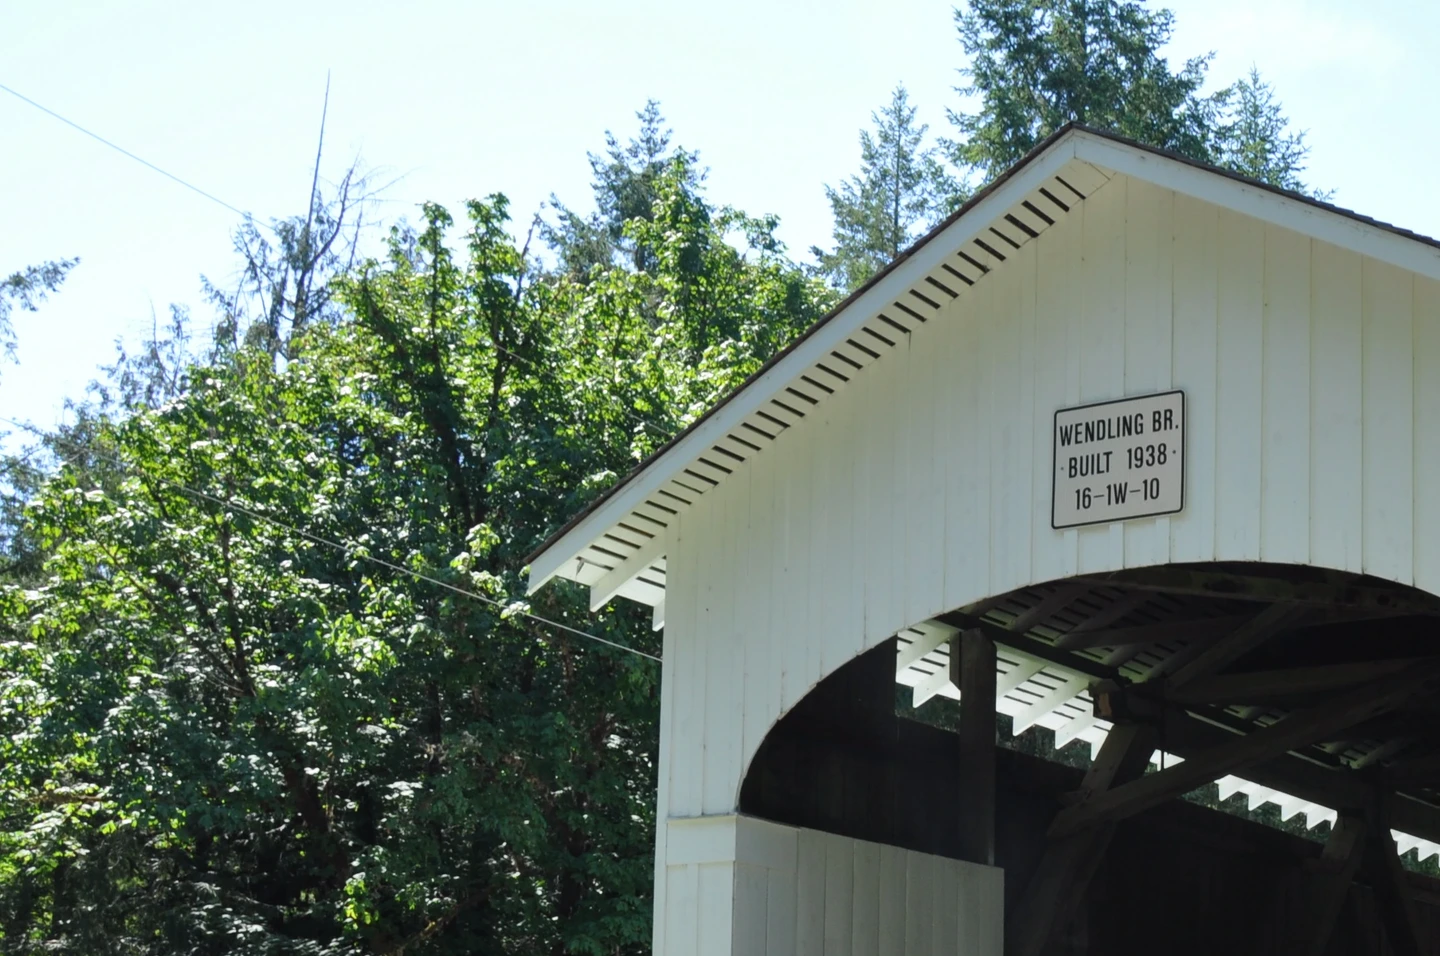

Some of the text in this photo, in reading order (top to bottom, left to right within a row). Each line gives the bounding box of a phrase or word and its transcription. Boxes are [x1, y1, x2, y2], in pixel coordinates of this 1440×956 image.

[1059, 408, 1179, 447] WENDLING BR.
[1068, 443, 1167, 479] BUILT 1938
[1075, 477, 1160, 510] 16-1W-10
